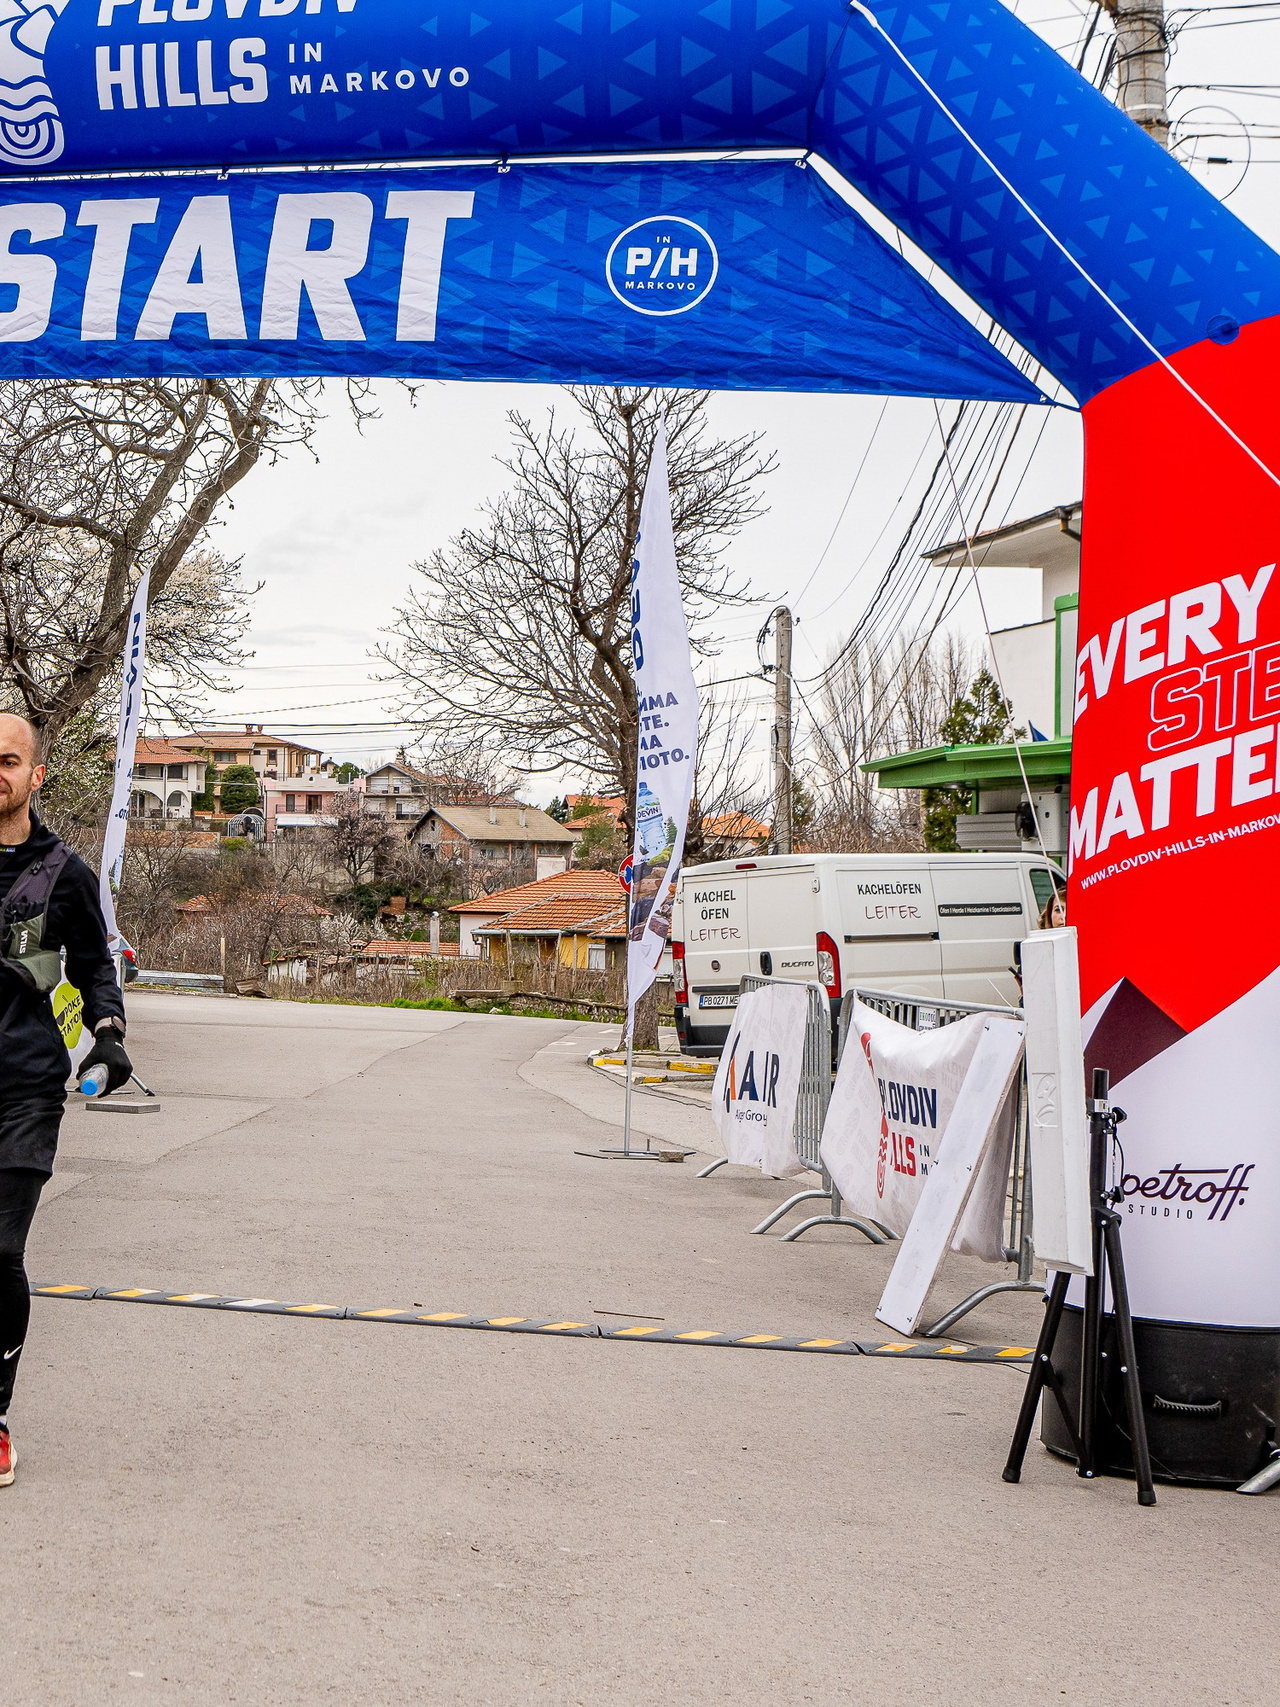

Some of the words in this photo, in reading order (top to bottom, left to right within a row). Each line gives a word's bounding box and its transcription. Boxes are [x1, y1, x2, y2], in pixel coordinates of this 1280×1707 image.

[289, 42, 322, 63] IN
[95, 37, 269, 110] HILLS
[290, 66, 470, 95] MARKOVO
[626, 247, 698, 278] P/H
[625, 281, 696, 290] MARKOVO
[1073, 563, 1276, 726] EVERY
[1068, 722, 1280, 878] MATTE
[694, 890, 736, 904] KACHEL
[701, 907, 729, 920] ÖFEN
[865, 905, 922, 919] LEITER
[690, 927, 742, 942] LEITER
[64, 994, 81, 1018] POKE
[1128, 1204, 1193, 1220] STUDIO
